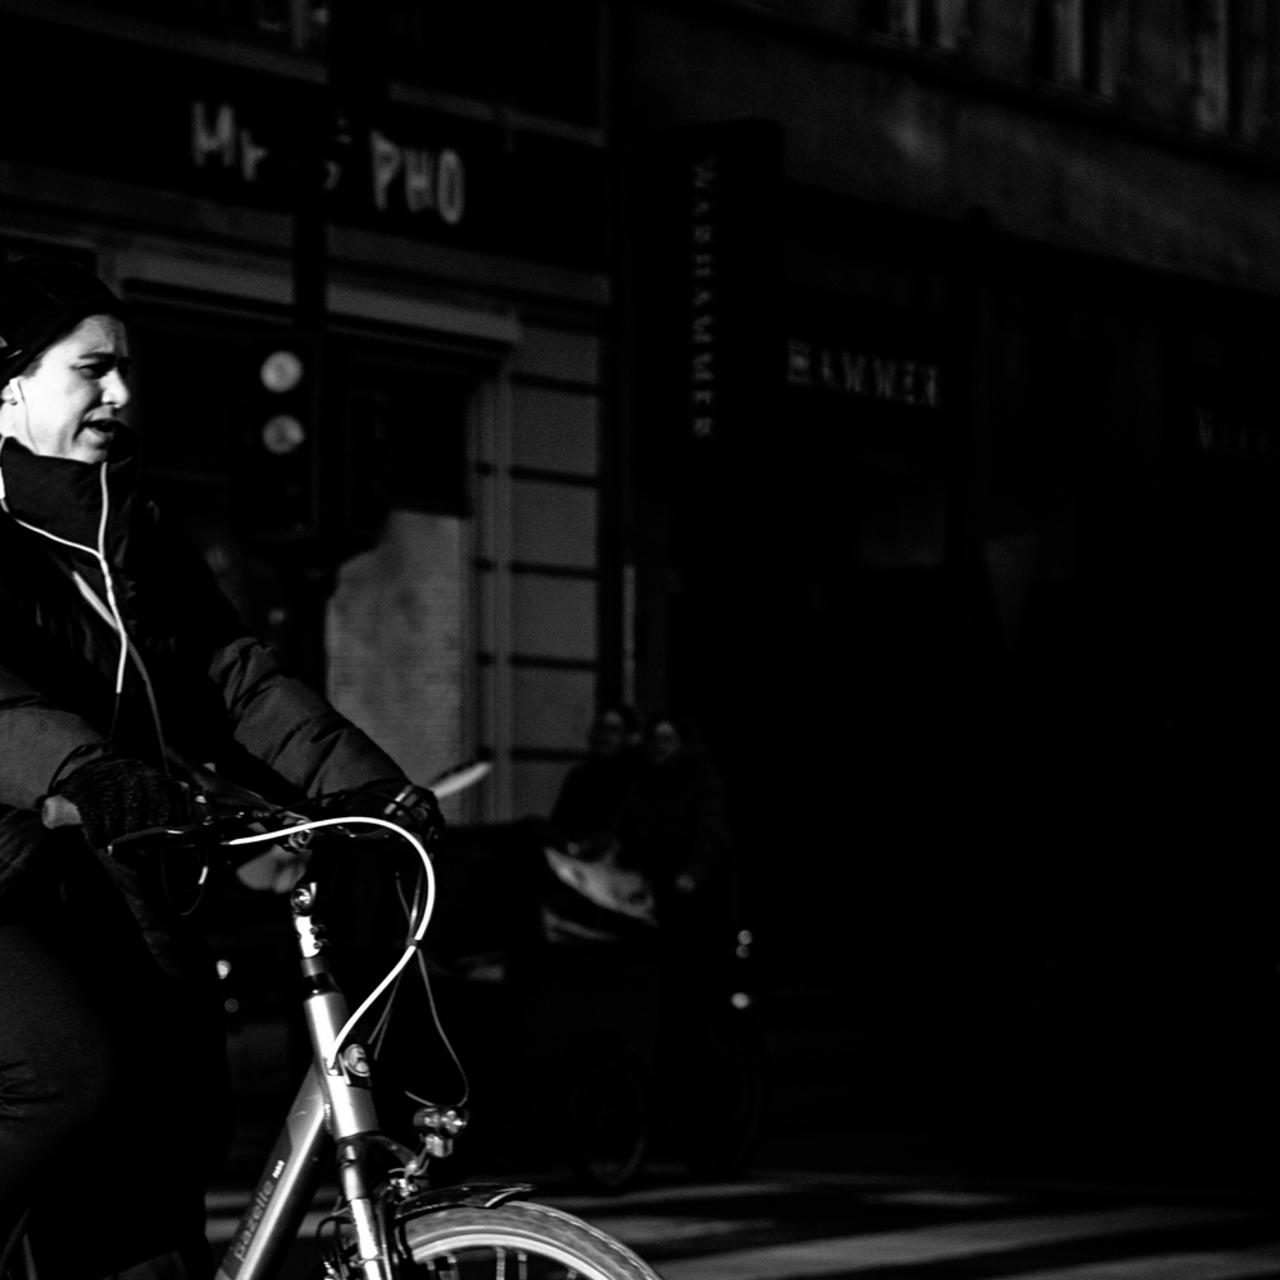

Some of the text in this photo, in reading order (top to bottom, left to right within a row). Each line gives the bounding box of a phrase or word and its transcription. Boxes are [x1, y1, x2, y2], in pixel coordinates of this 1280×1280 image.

[368, 127, 466, 227] PHO
[688, 157, 718, 440] WARHAMMER
[785, 338, 943, 409] HAMMER
